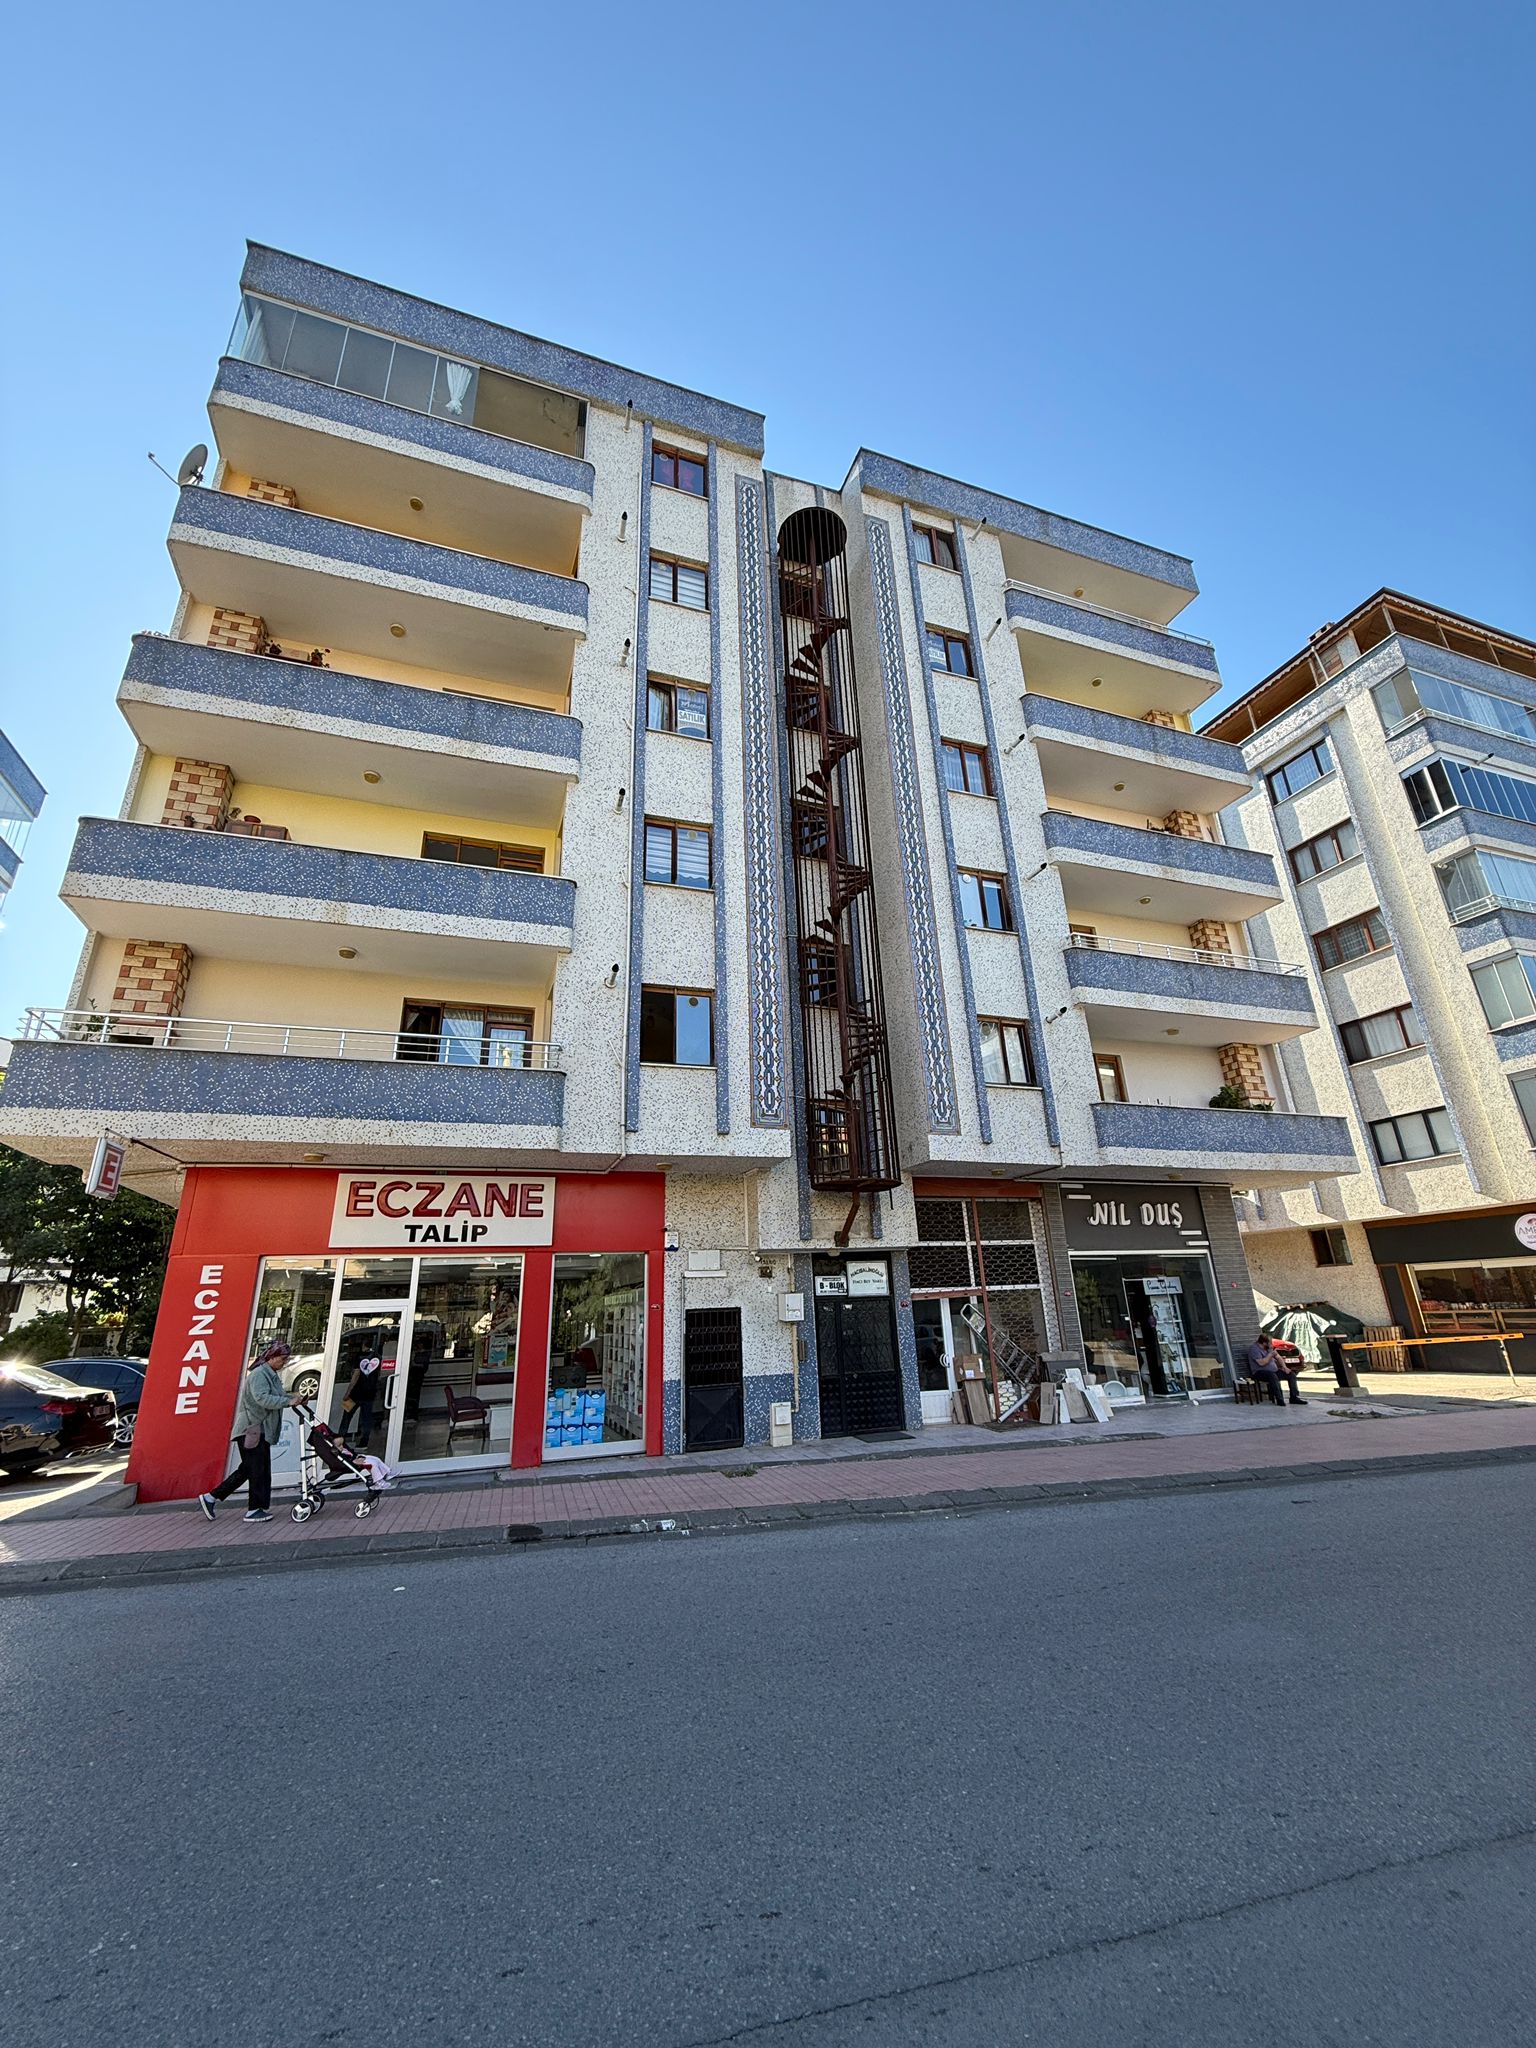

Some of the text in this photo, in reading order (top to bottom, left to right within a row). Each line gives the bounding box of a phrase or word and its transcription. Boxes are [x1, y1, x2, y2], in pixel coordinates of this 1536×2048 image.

[679, 711, 704, 723] SATILIK
[101, 1153, 118, 1186] E
[346, 1181, 544, 1218] ECZANE
[1087, 1201, 1183, 1228] NİL DUŞ
[404, 1220, 488, 1243] TALİP
[829, 1282, 844, 1290] BLOK
[175, 1265, 224, 1414] ECZANE
